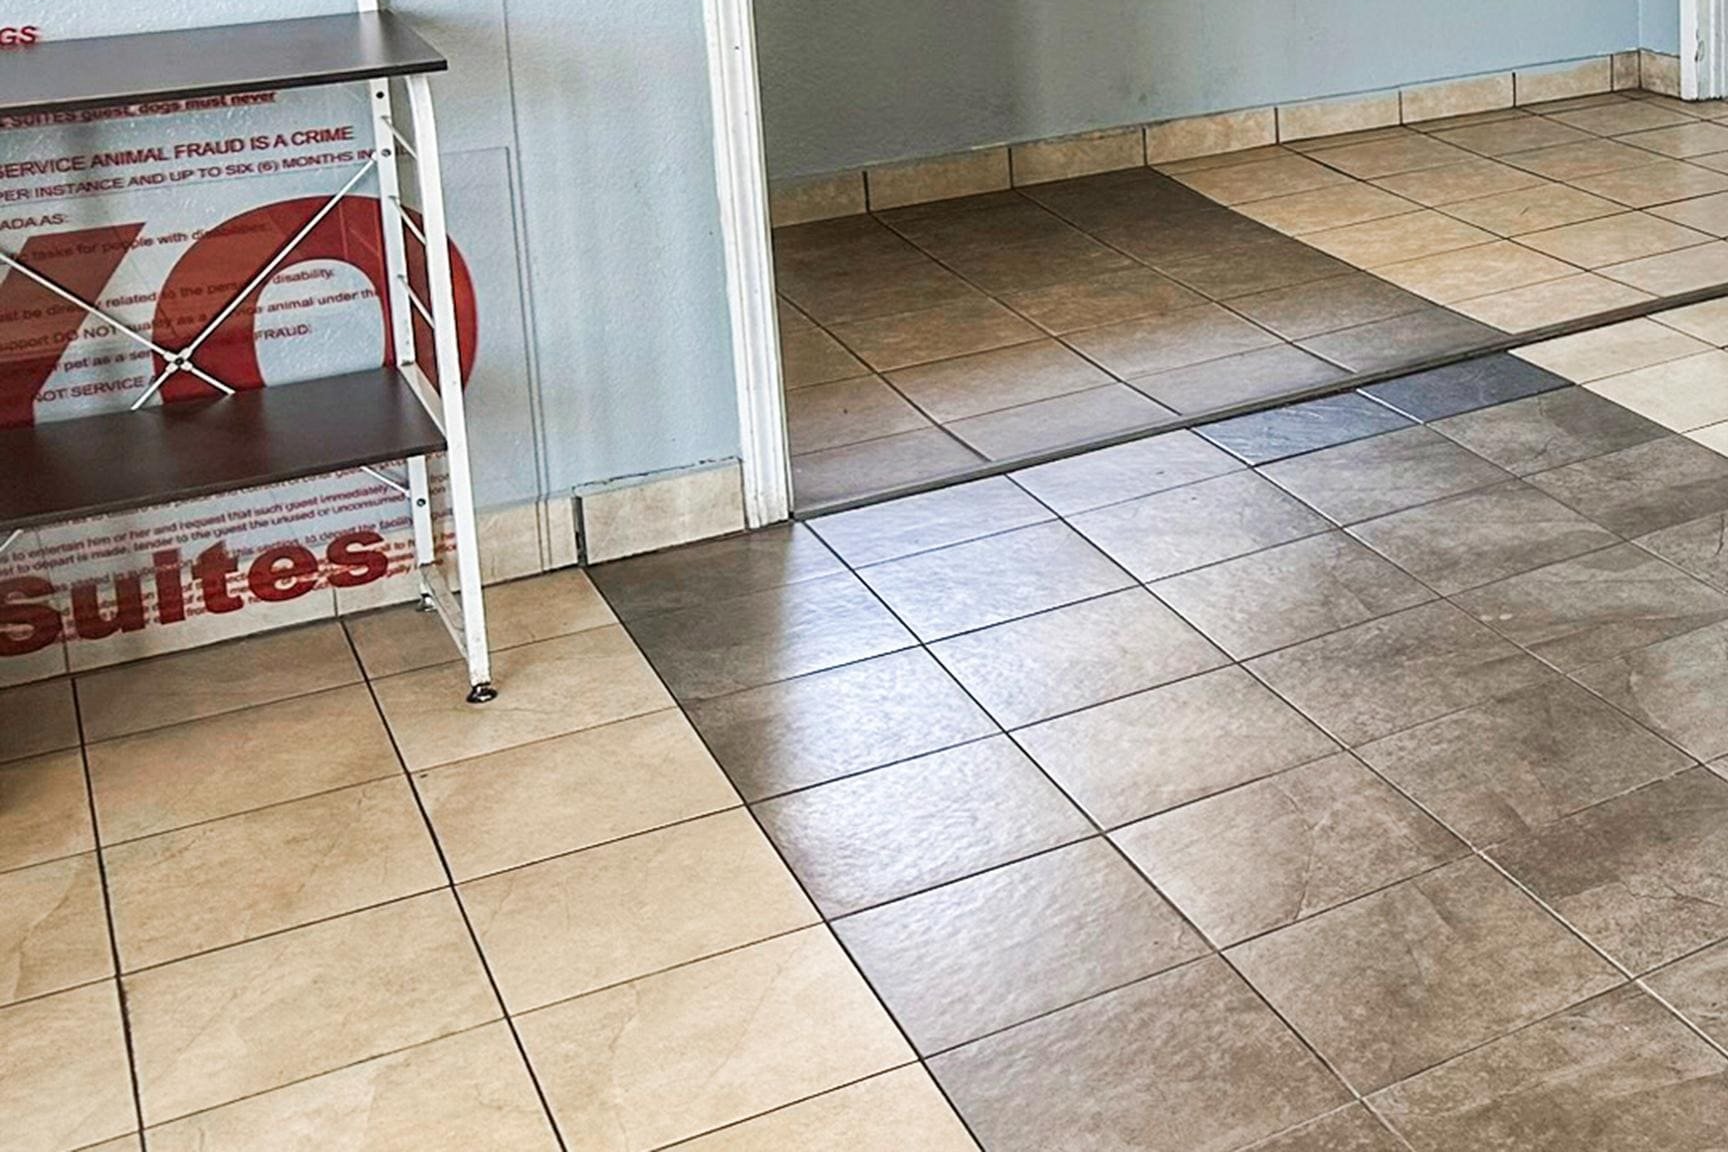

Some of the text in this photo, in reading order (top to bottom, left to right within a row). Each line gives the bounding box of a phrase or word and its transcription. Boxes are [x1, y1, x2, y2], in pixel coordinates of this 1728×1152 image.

[0, 126, 355, 180] SERVICE ANIMAL FRAUD IS A CRIME
[34, 178, 125, 198] INSTANCE
[127, 172, 166, 187] AND
[169, 169, 194, 183] UP
[198, 165, 222, 179] TO
[225, 163, 255, 176] SIX
[257, 159, 280, 174] (6)
[282, 151, 353, 169] MONTHS
[156, 232, 188, 245] with
[106, 293, 156, 308] related
[84, 324, 117, 340] NOT
[267, 296, 315, 312] animal
[317, 291, 360, 307] under
[64, 357, 88, 373] pet
[92, 354, 111, 367] as
[71, 375, 144, 397] SERVICE
